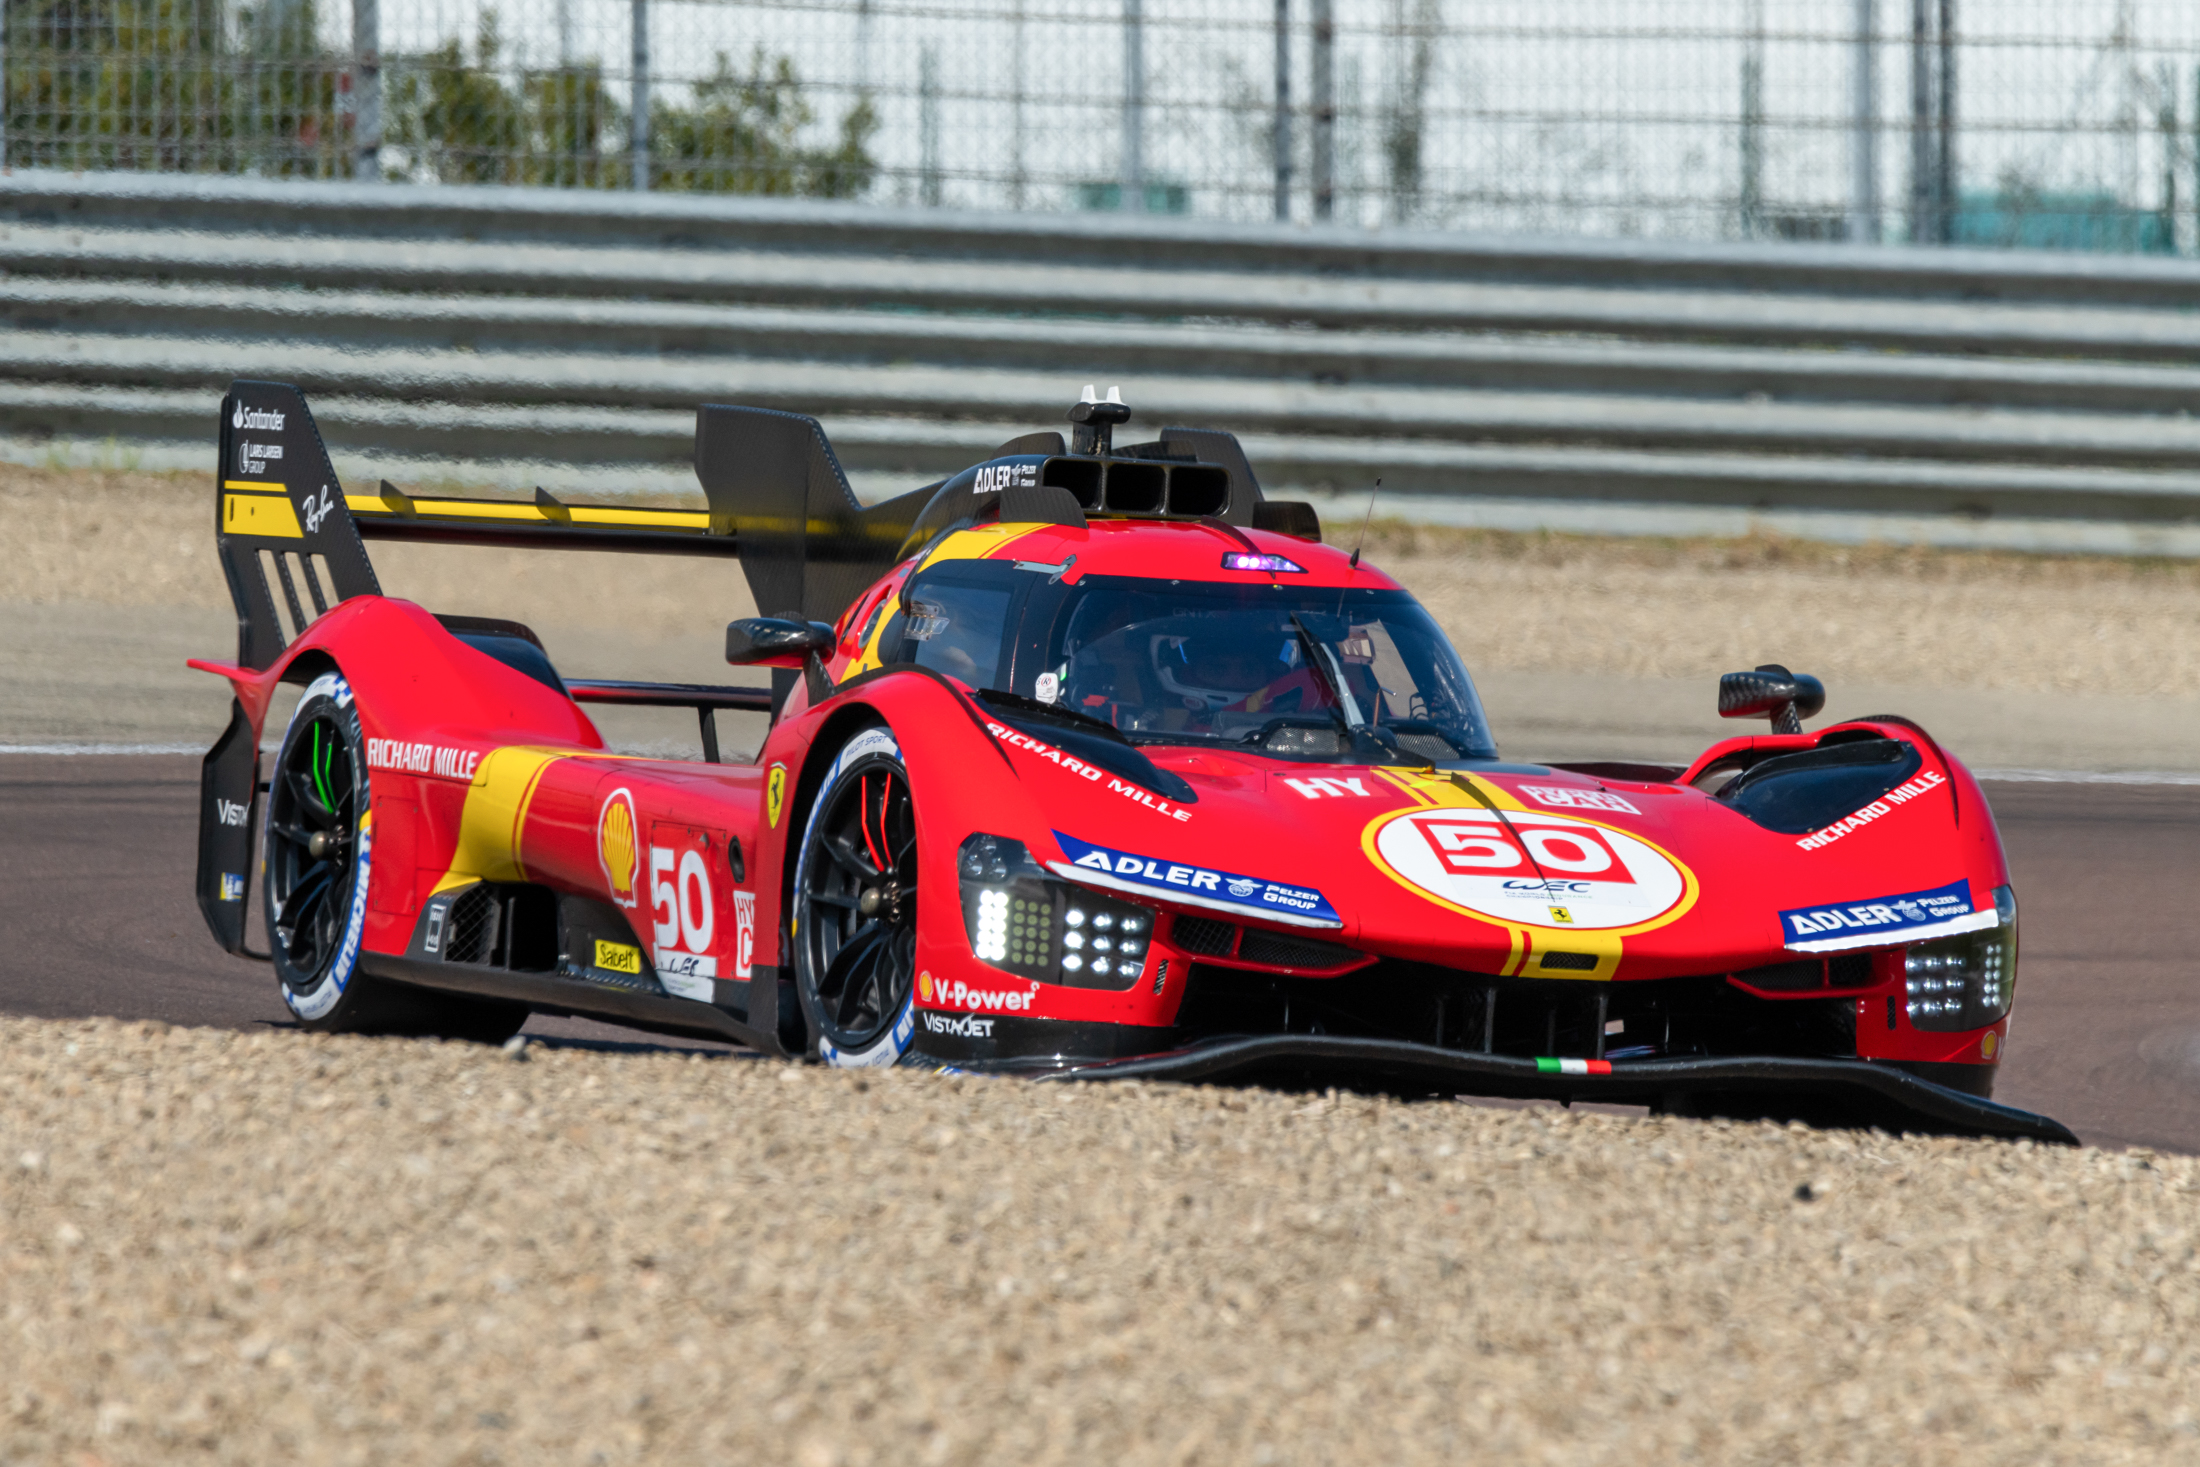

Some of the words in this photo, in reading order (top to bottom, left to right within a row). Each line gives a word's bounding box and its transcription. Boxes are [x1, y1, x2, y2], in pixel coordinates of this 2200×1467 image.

[244, 407, 285, 431] Santander
[973, 465, 1011, 494] ADLER
[865, 735, 888, 747] SPORT
[367, 737, 434, 773] RICHARD
[433, 746, 479, 780] MILLE
[986, 722, 1103, 782] RICHARD
[1107, 778, 1193, 822] MILLE
[1283, 777, 1371, 799] HY
[1796, 801, 1892, 851] RICHARD
[1884, 770, 1947, 806] MILLE
[1427, 824, 1613, 873] 50
[1074, 851, 1222, 891] ADLER
[1266, 884, 1320, 902] PELZER
[1502, 880, 1592, 894] WEC
[651, 847, 714, 954] 50
[1263, 892, 1317, 910] GROUP
[1788, 903, 1902, 935] ADLER
[1916, 895, 1961, 908] PELZER
[1929, 904, 1971, 917] GROUP
[600, 943, 635, 970] Sabelt
[934, 978, 1036, 1010] V-Power
[923, 1011, 995, 1037] VISTAJET
